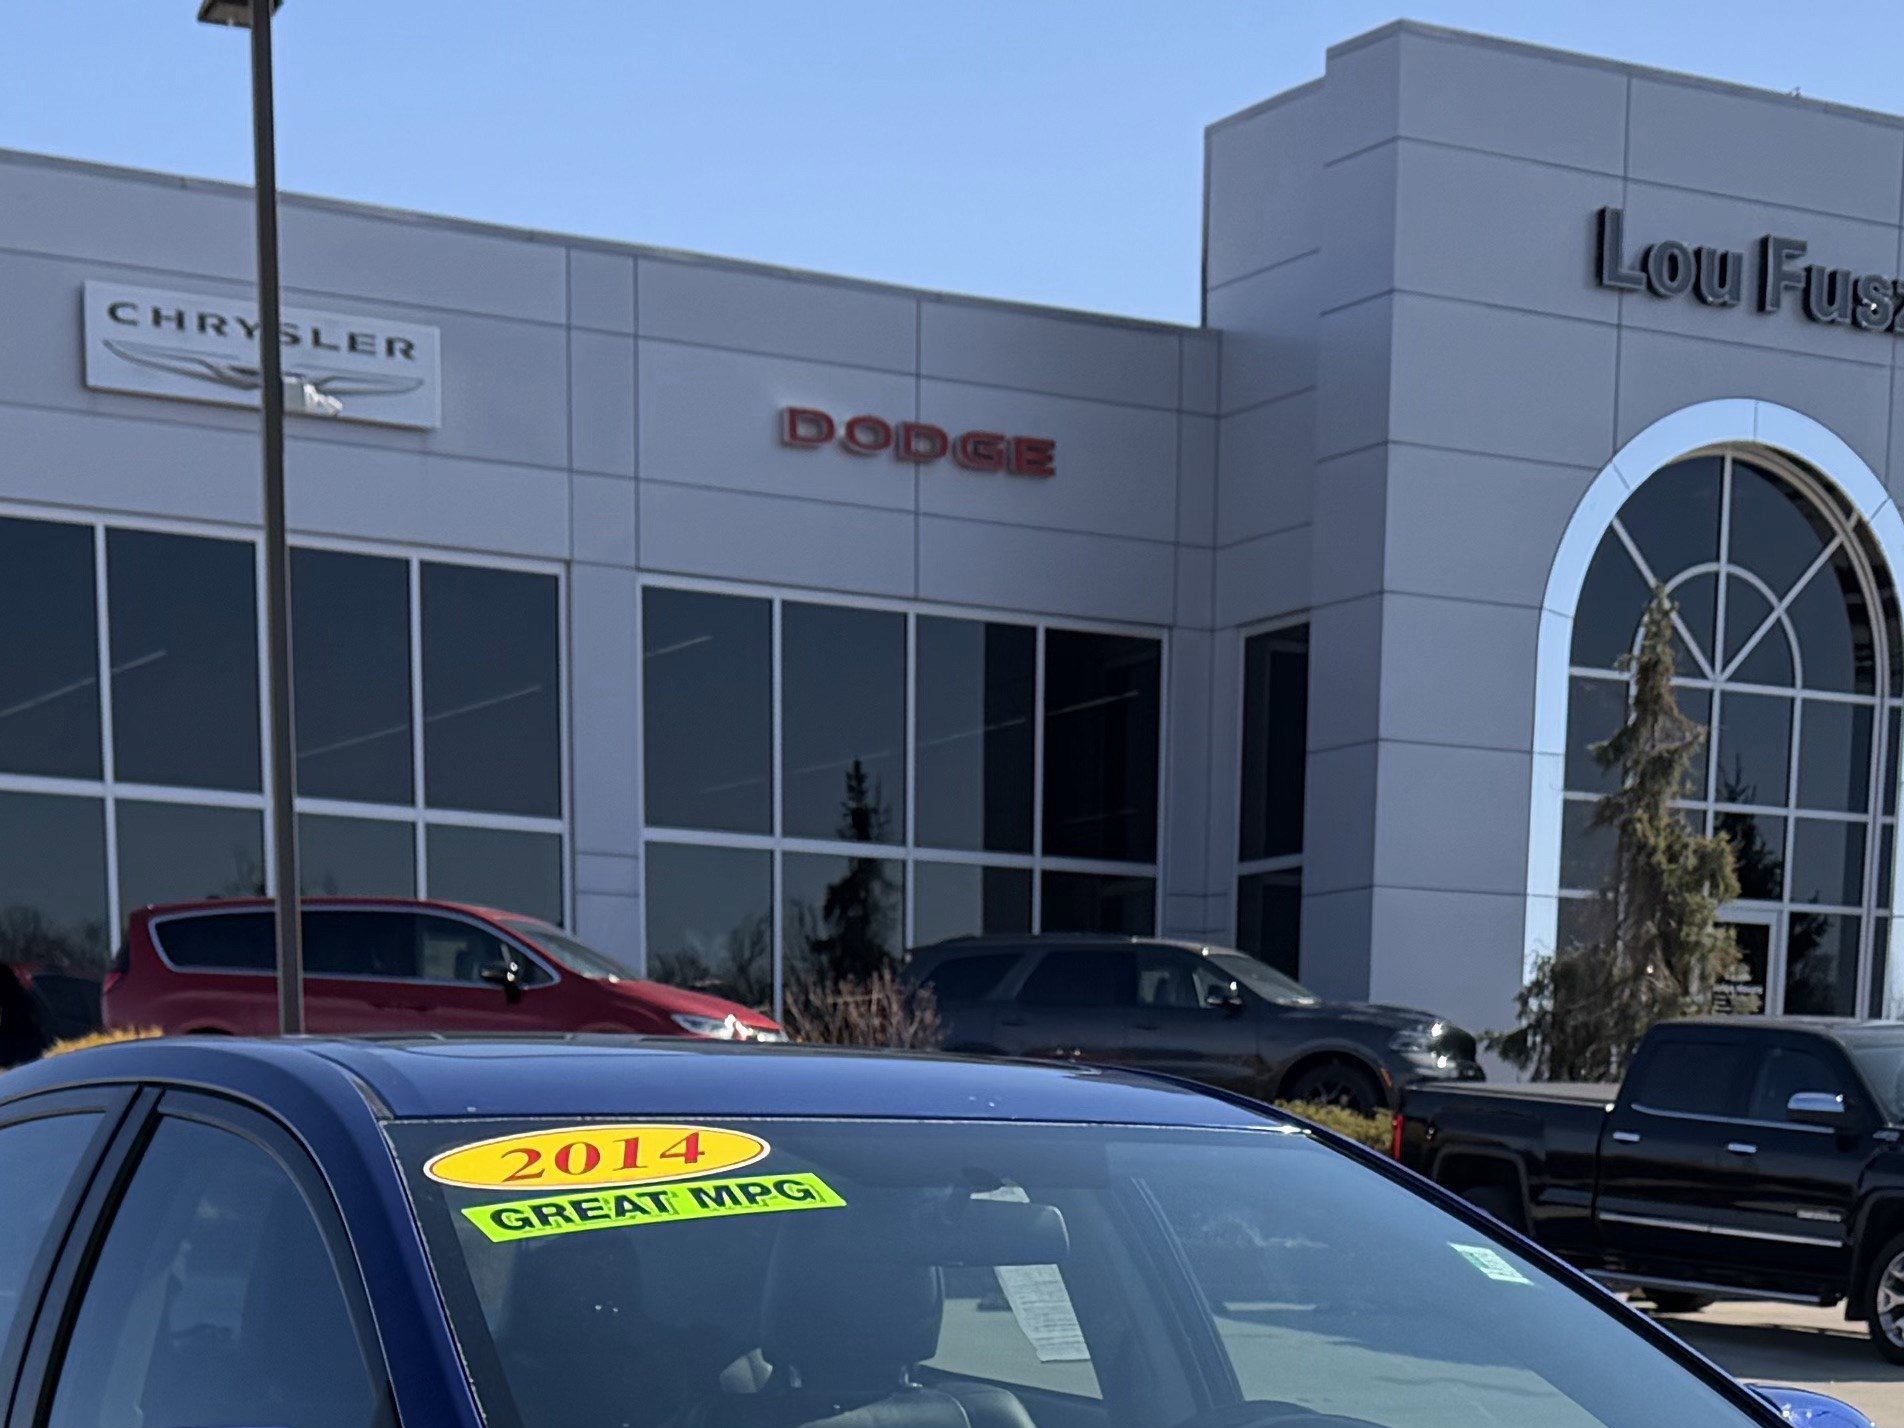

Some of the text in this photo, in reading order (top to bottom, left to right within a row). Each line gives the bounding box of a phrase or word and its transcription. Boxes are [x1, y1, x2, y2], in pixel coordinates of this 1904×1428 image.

[1597, 206, 1743, 307] Lou
[107, 301, 416, 360] CHRYSLER
[781, 406, 1056, 477] DODGE
[500, 1131, 705, 1183] 2014
[490, 1180, 818, 1232] GREAT MPG
